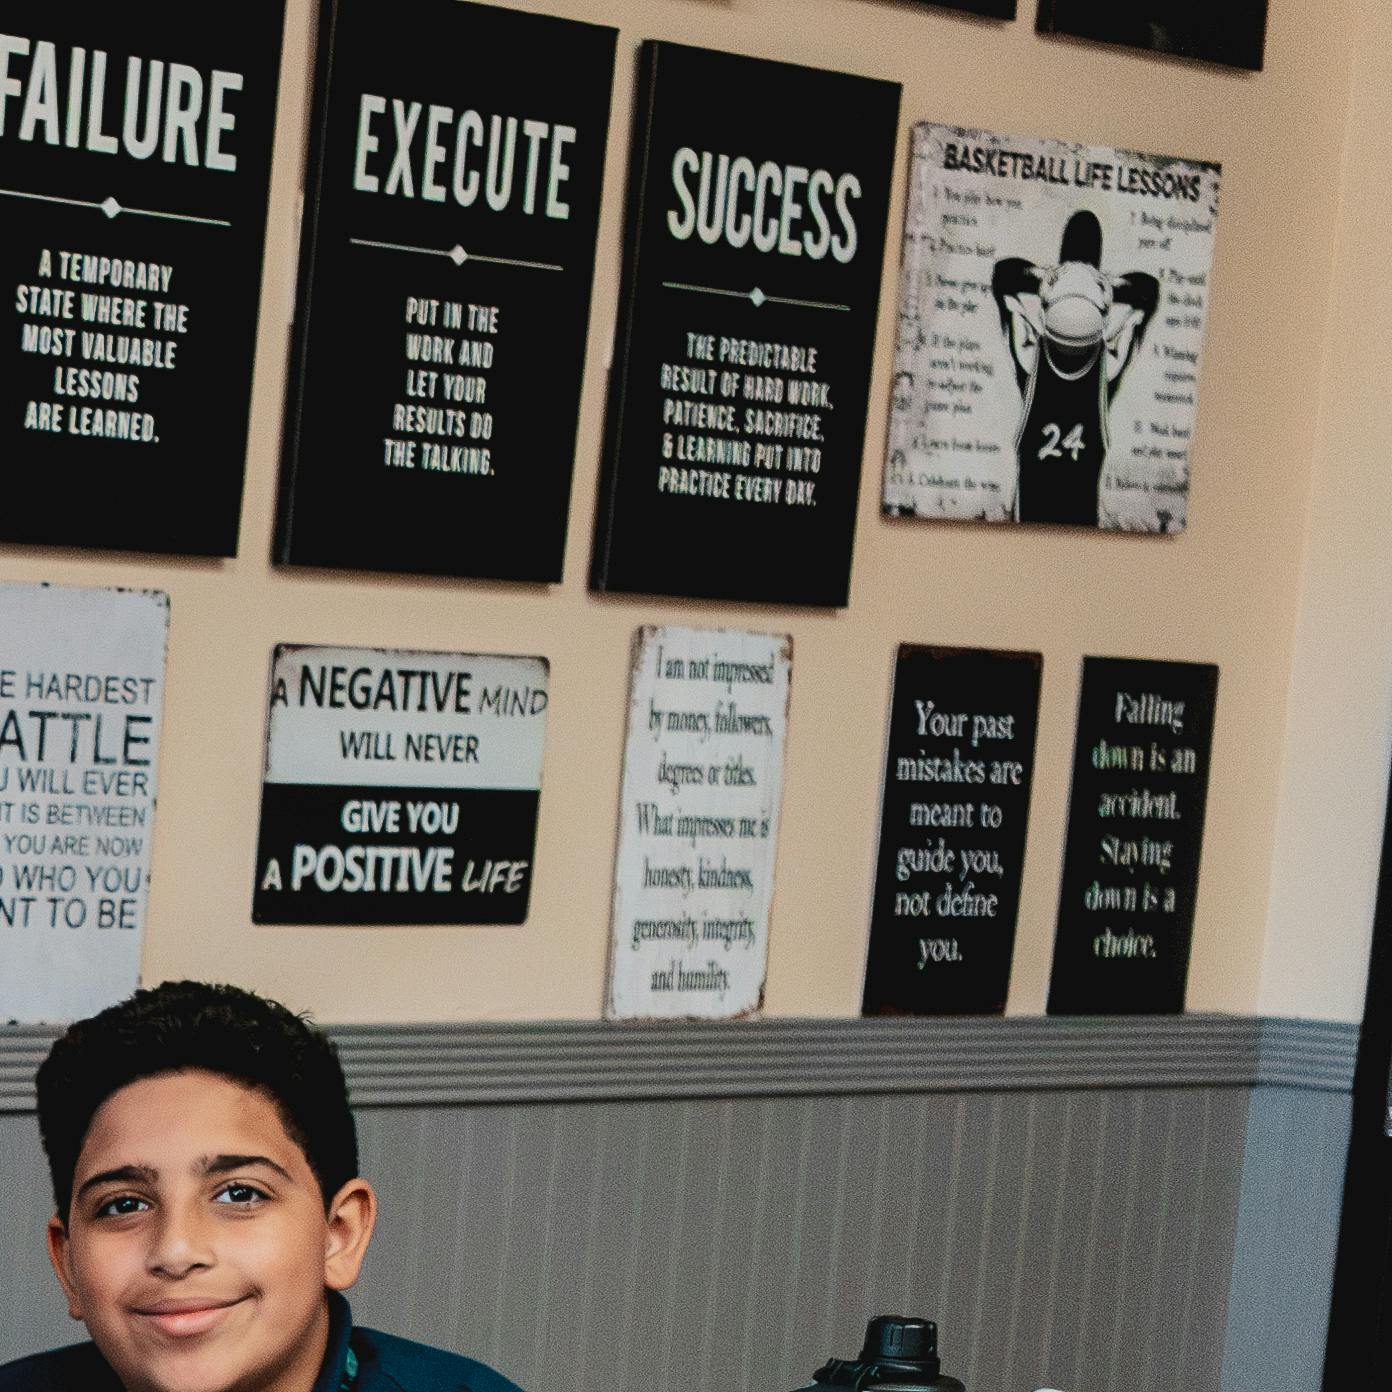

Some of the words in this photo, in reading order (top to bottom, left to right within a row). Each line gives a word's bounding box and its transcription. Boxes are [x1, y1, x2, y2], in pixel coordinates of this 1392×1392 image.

[355, 95, 575, 218] EXECUTE
[943, 143, 1069, 185] BASKETBALL
[1074, 160, 1113, 191] LIFE
[1117, 167, 1201, 202] LESSONS
[668, 149, 860, 261] SUCCESS
[38, 249, 52, 278] A
[60, 251, 172, 292] TEMPORARY
[16, 284, 75, 319] STATE
[81, 293, 147, 328] WHERE
[154, 302, 189, 333] THE
[405, 297, 439, 326] PUT
[443, 302, 462, 329] IN
[468, 304, 499, 334] THE
[22, 324, 76, 357] MOST
[82, 332, 176, 369] VALUABLE
[406, 334, 455, 364] WORK
[458, 340, 494, 369] AND
[687, 332, 715, 361] THE
[720, 337, 817, 373] PREDICTABLE
[55, 367, 139, 402] LESSONS
[407, 369, 438, 398] LET
[443, 374, 486, 403] YOUR
[24, 401, 63, 432] ARE
[69, 407, 159, 442] LEARNED.
[393, 404, 466, 437] RESULTS
[469, 412, 493, 440] DO
[663, 399, 739, 432] PATIENCE,
[745, 409, 824, 441] SACRIFICE,
[384, 438, 416, 468] THE
[422, 443, 494, 475] TALKING.
[1038, 423, 1085, 460] 24
[658, 466, 731, 498] PRACTICE
[734, 474, 782, 503] EVERY
[785, 479, 816, 506] DAY.
[26, 673, 154, 704] HARDEST
[269, 676, 289, 709] A
[299, 665, 471, 713] NEGATIVE
[479, 686, 549, 716] MIND
[916, 700, 968, 737] Your
[972, 715, 1014, 747] past
[1115, 693, 1184, 733] Falling
[340, 731, 395, 761] WILL
[405, 734, 479, 763] NEVER
[18, 768, 75, 795] WILL
[83, 770, 148, 797] EVER
[897, 748, 985, 783] mistakes
[989, 761, 1023, 785] are
[21, 802, 40, 824] IS
[46, 804, 146, 827] BETWEEN
[341, 800, 401, 833] GIVE
[407, 801, 460, 834] YOU
[910, 803, 974, 827] meant
[980, 804, 1003, 828] to
[4, 834, 46, 855] YOU
[50, 835, 89, 856] ARE
[96, 836, 143, 857] NOW
[897, 838, 955, 881] guide
[960, 850, 1004, 881] you,
[14, 865, 76, 892] WHO
[86, 866, 141, 893] YOU
[262, 858, 282, 890] A
[292, 845, 453, 892] POSITIVE
[462, 860, 528, 893] LIFE
[47, 897, 87, 929] TO
[98, 898, 136, 929] BE
[895, 892, 930, 916] not
[936, 882, 998, 917] define
[918, 939, 963, 970] you.
